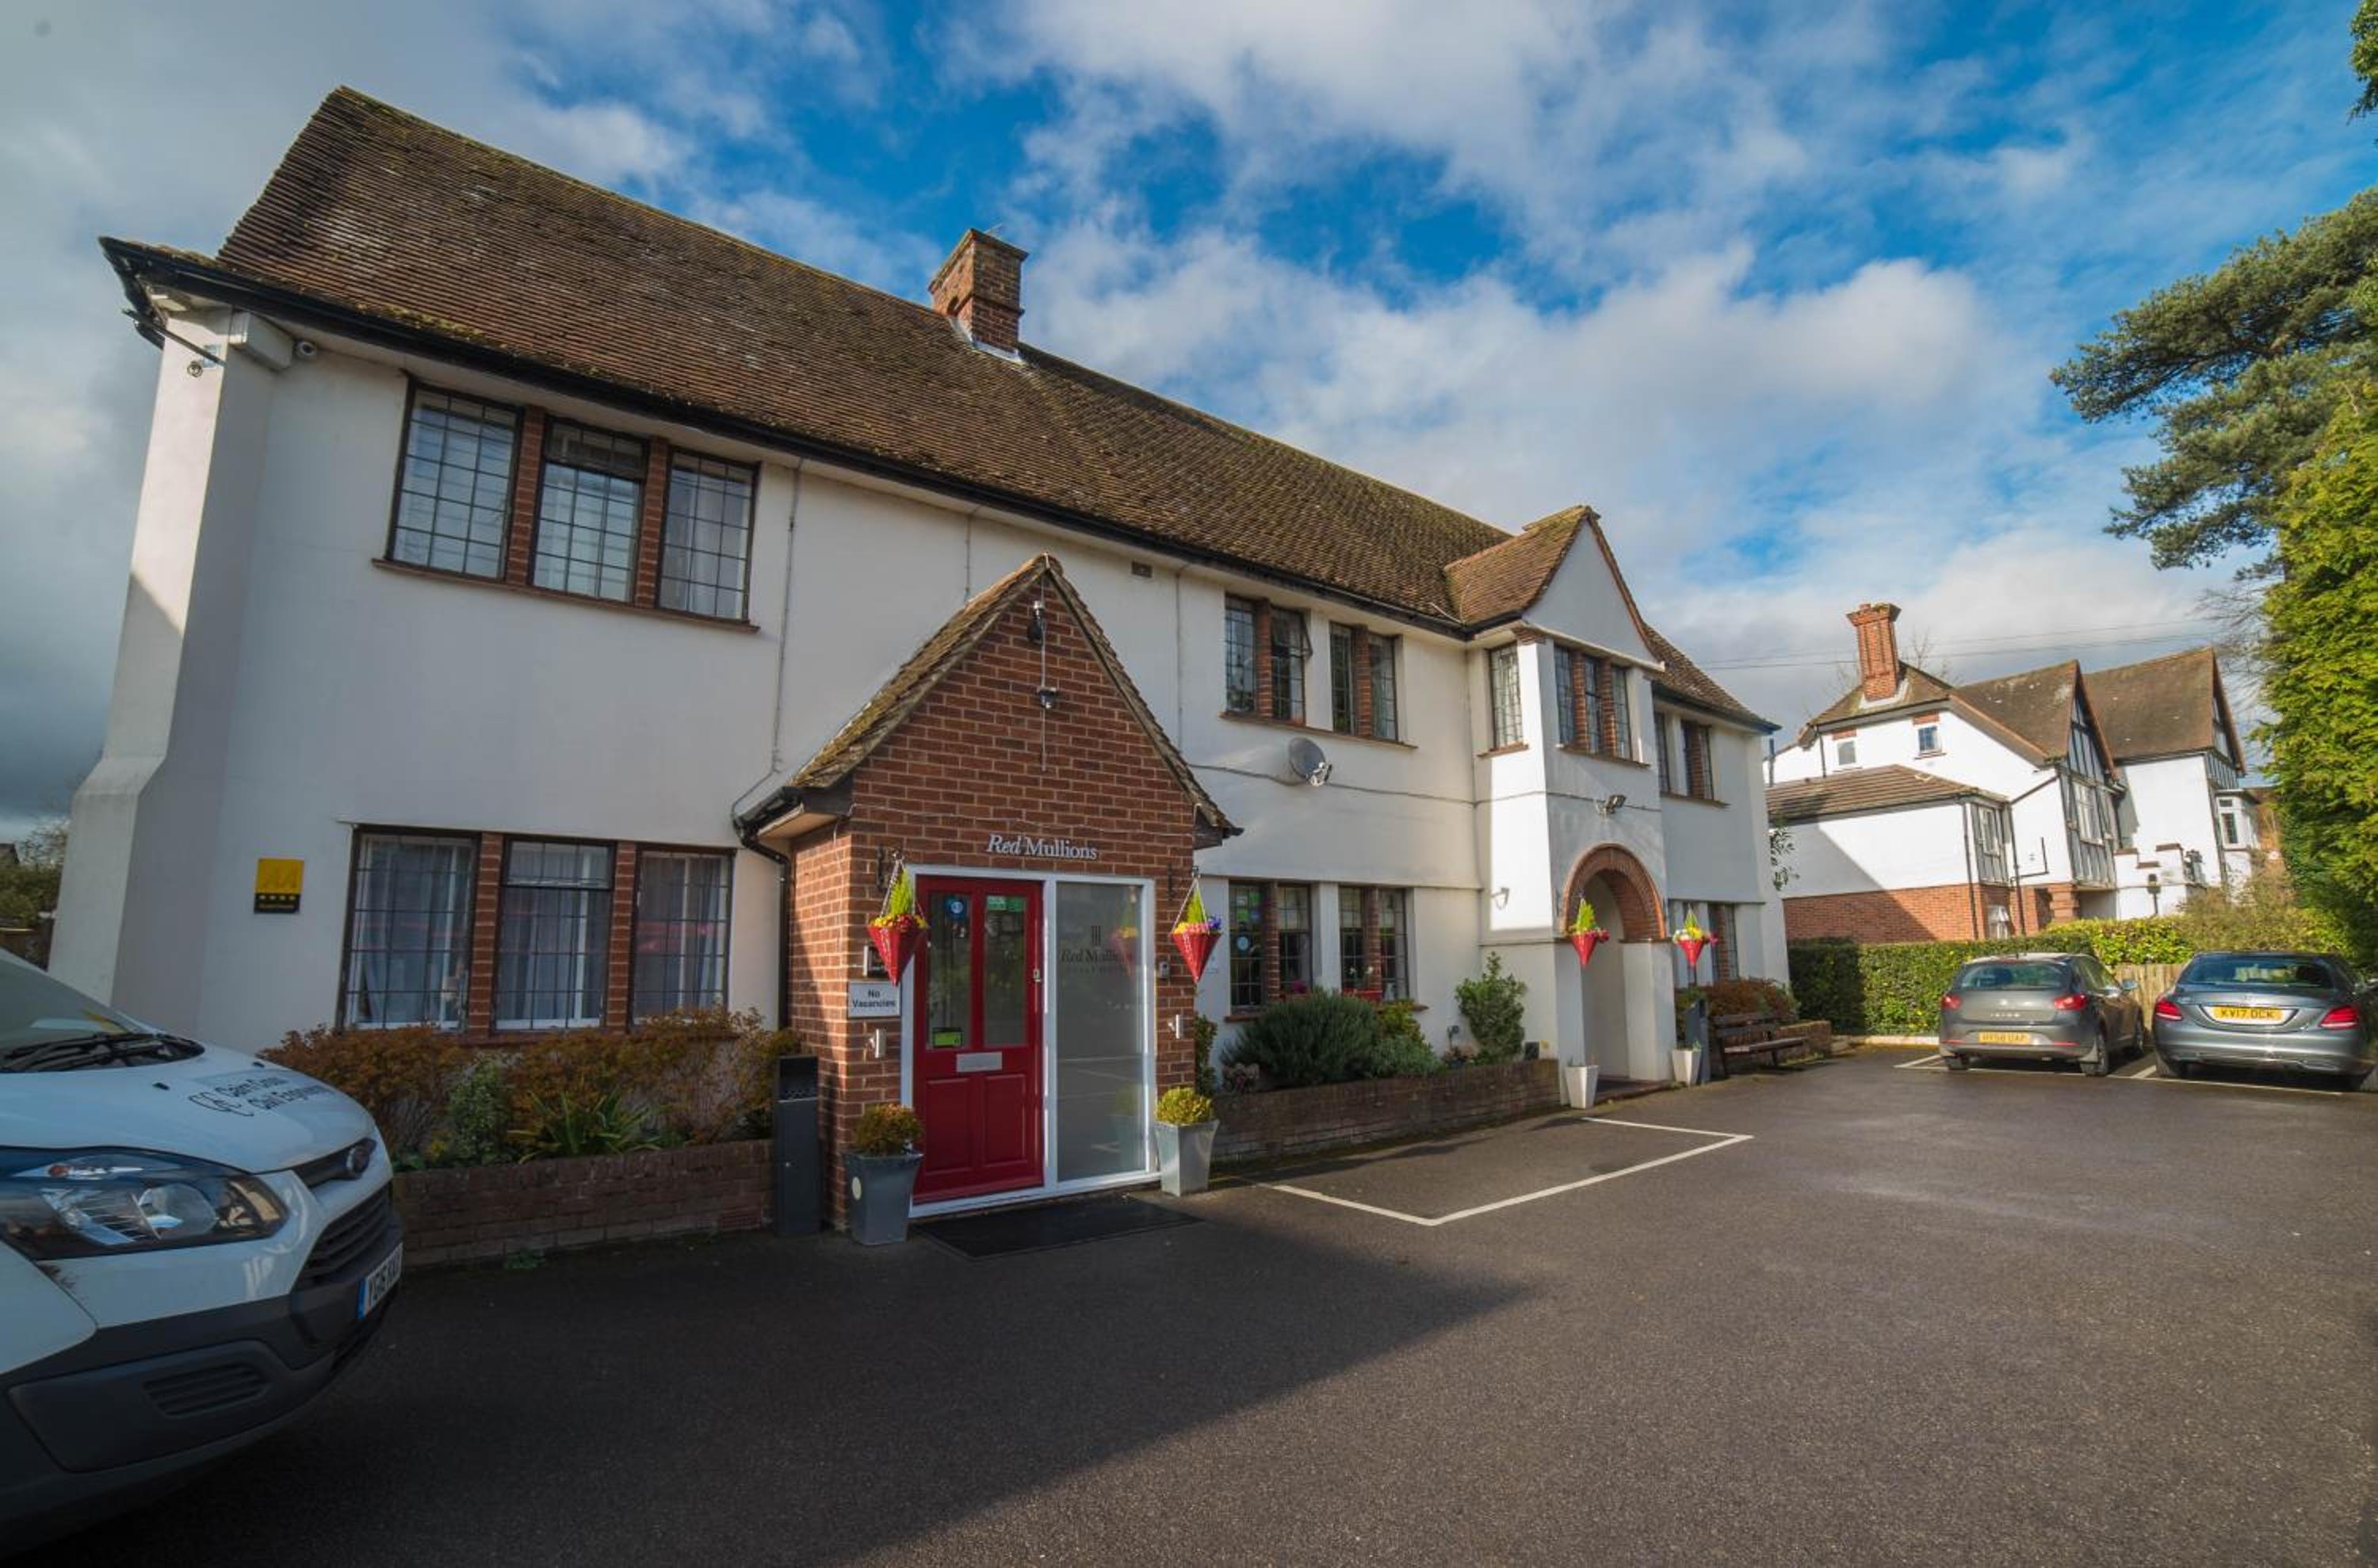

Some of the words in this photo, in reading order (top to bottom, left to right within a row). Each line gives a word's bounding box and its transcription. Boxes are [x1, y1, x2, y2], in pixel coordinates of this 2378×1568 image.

[985, 833, 1022, 855] Red
[1023, 836, 1098, 860] Mullions
[1060, 949, 1084, 962] Red
[868, 989, 881, 998] No
[852, 999, 896, 1008] Vacancies
